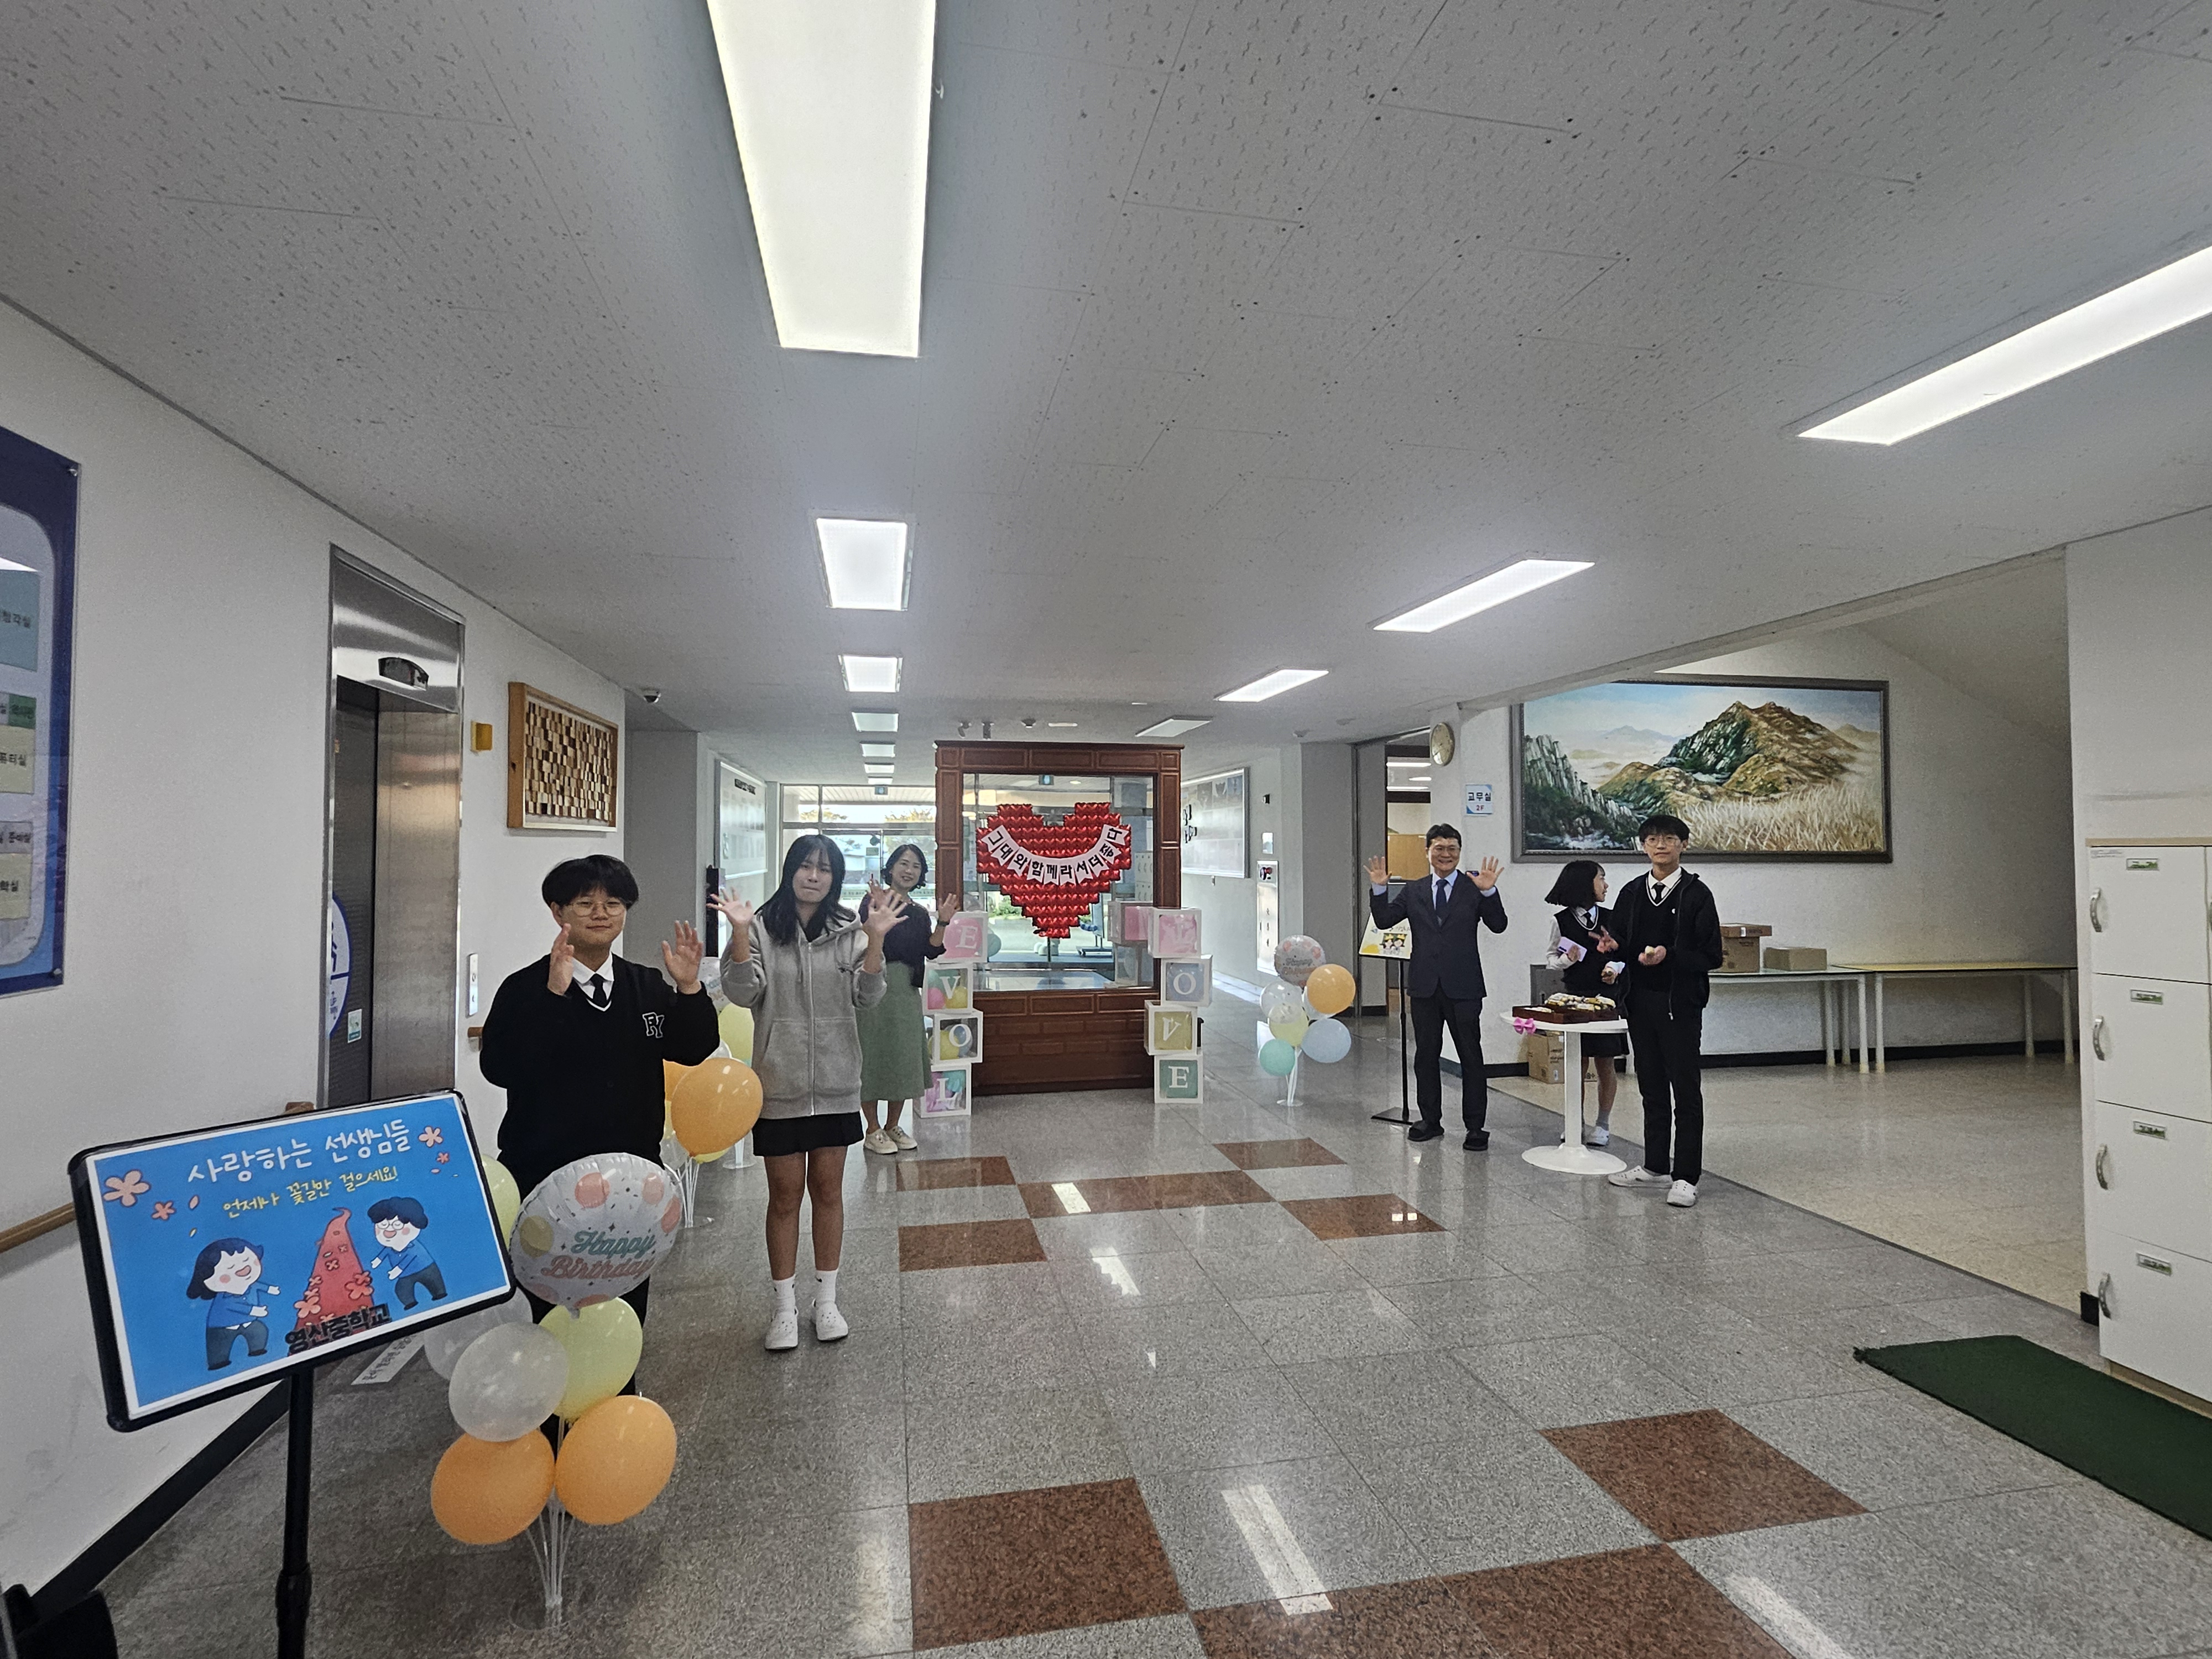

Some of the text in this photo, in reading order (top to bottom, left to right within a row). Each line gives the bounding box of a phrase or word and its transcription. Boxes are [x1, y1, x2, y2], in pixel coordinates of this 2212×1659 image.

[1468, 792, 1491, 801] 교무실
[188, 1119, 411, 1182] 사랑하는 선생님들
[223, 1192, 280, 1218] 언제나
[286, 1179, 332, 1206] 꽃길만
[570, 1230, 656, 1259] Happy
[540, 1255, 658, 1279] Birthday
[285, 1303, 392, 1354] 영산중학교
